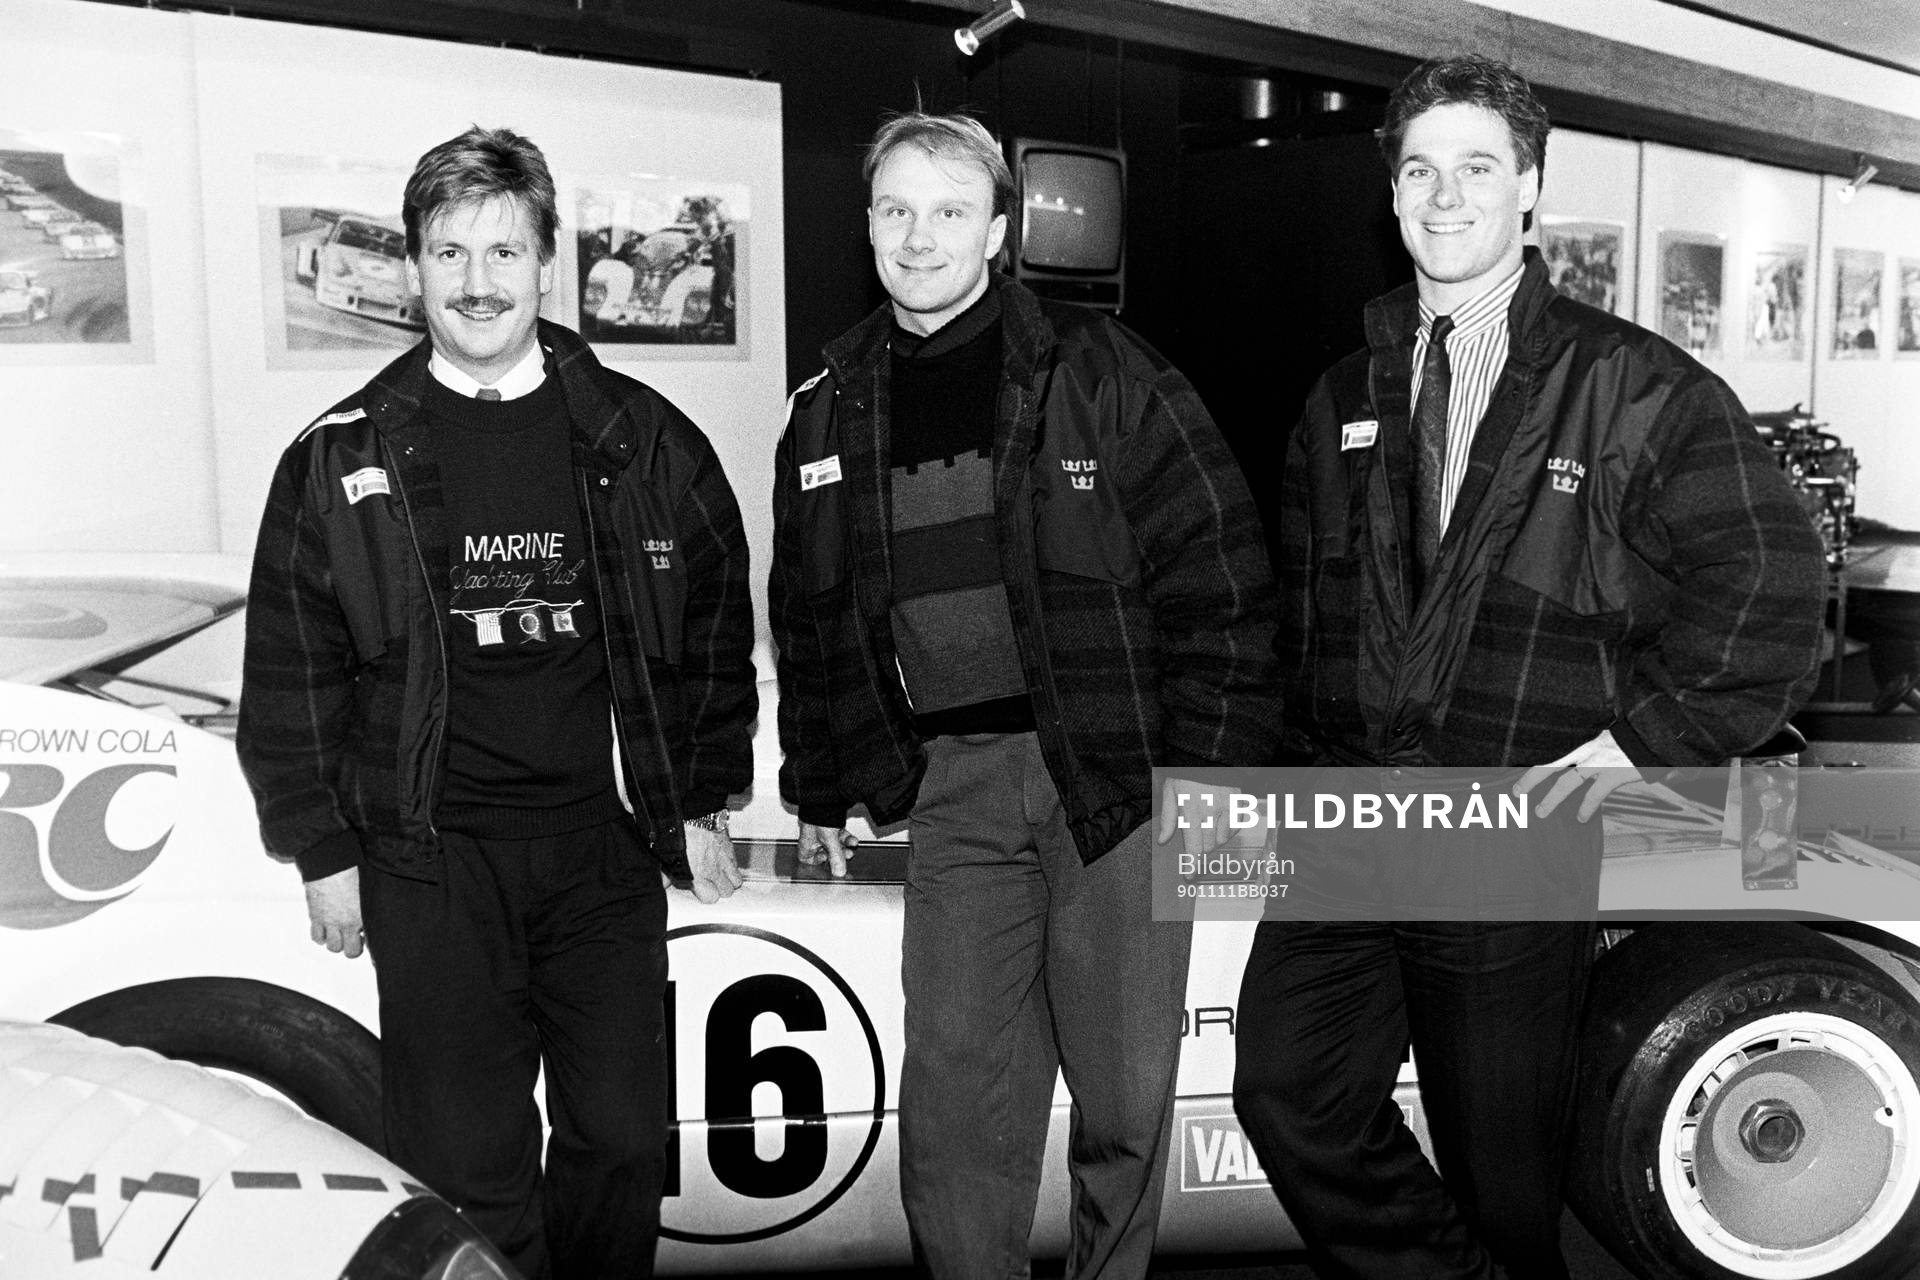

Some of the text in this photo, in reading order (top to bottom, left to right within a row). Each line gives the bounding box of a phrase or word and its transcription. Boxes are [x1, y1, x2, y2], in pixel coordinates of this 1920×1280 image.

[465, 532, 565, 562] MARINE
[449, 559, 585, 605] Yachting Club
[97, 729, 178, 753] COLA
